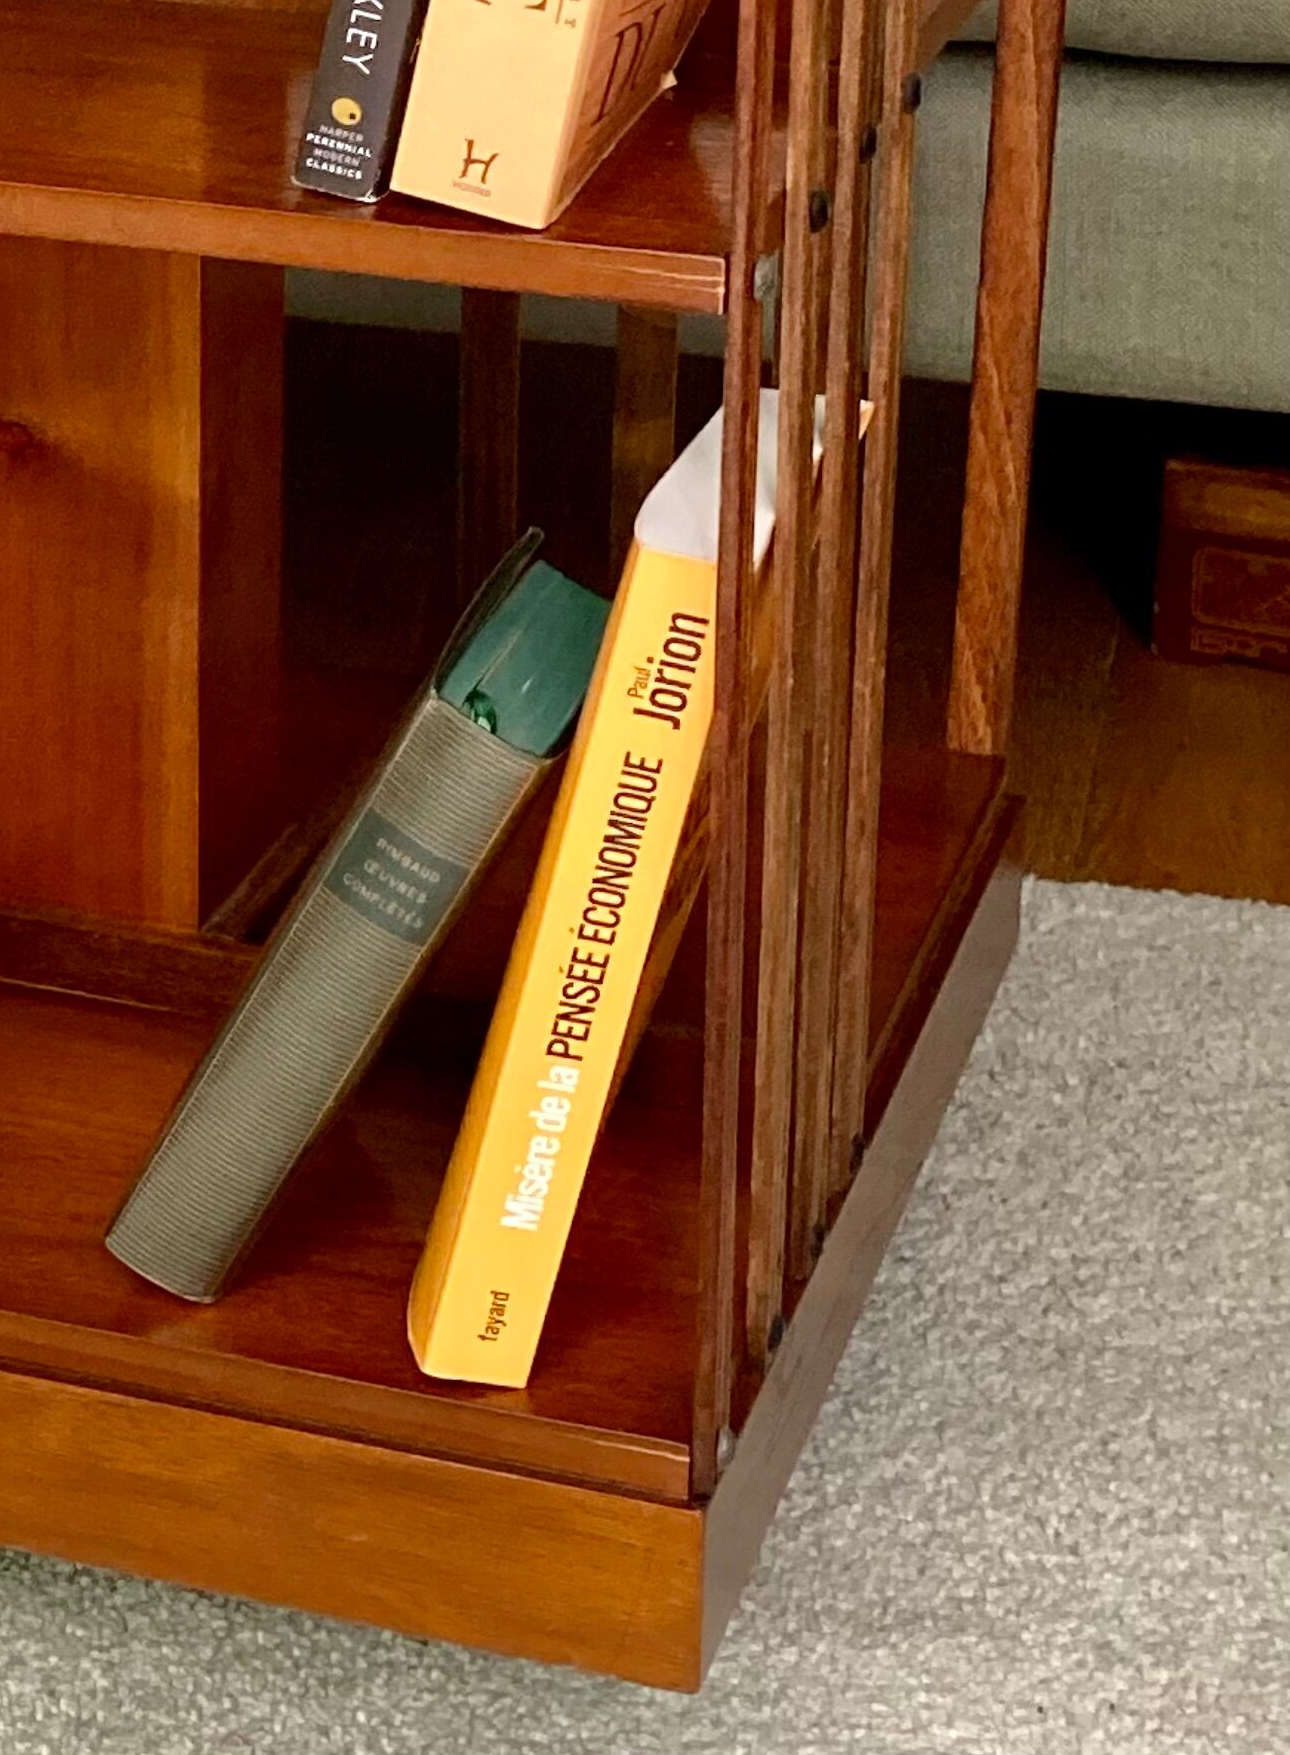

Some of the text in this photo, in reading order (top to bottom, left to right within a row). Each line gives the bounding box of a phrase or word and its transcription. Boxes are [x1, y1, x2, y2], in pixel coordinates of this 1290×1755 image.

[306, 132, 373, 159] PERENNIAL
[318, 124, 364, 143] HARPER
[305, 157, 363, 181] CLASSICS
[313, 147, 361, 167] MODERN
[627, 611, 710, 731] Paul Jorion
[376, 837, 441, 884] RIMBAUD
[568, 750, 664, 948] ÉCONOMIQUE
[547, 945, 611, 1063] PENSÉE
[536, 1063, 581, 1094] la
[528, 1094, 572, 1133] de
